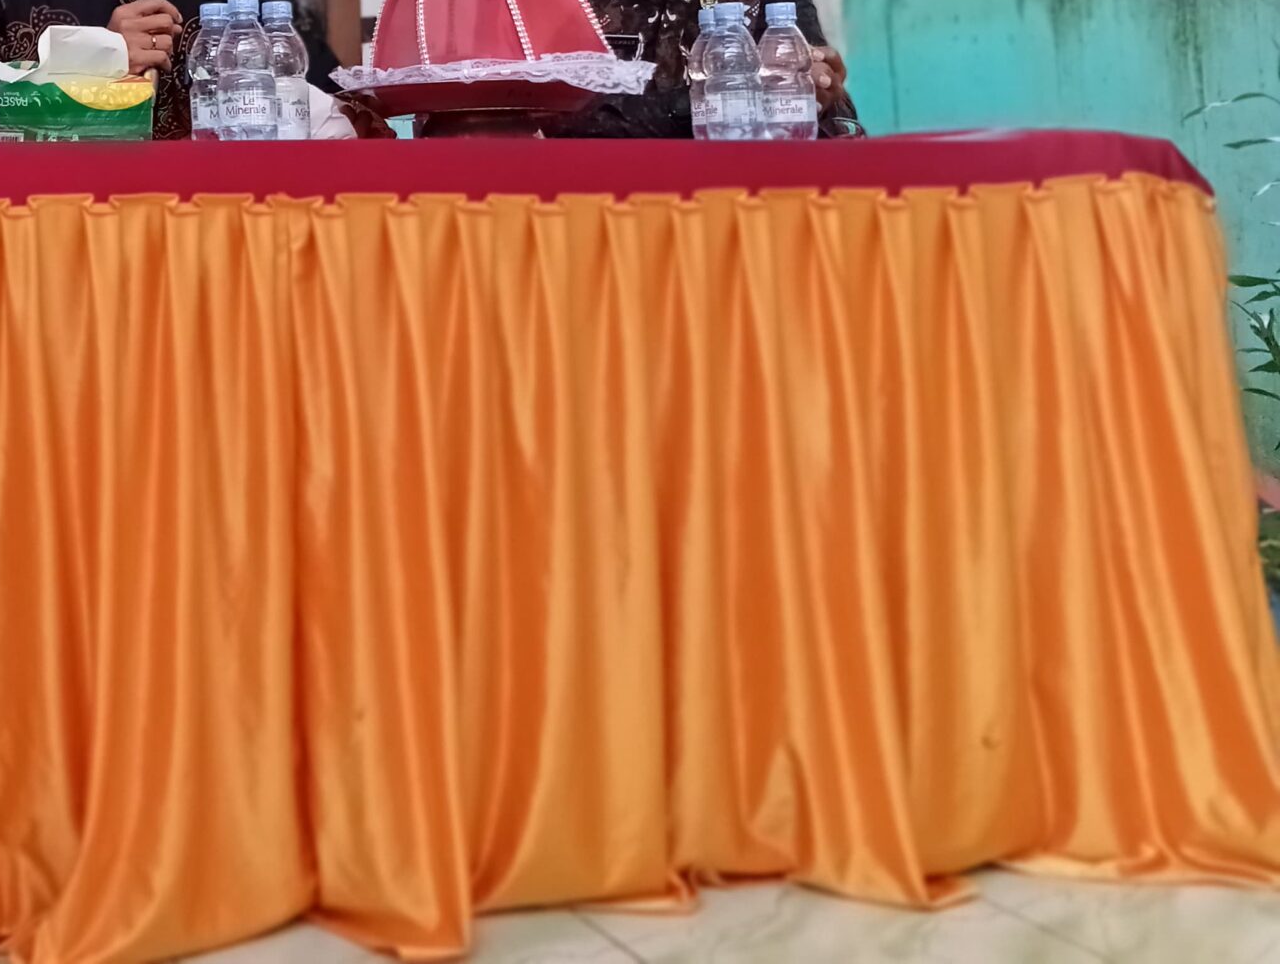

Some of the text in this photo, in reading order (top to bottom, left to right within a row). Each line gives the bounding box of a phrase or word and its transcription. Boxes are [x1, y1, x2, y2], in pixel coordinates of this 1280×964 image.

[243, 96, 255, 105] Le
[780, 98, 791, 106] Le
[225, 105, 267, 115] Minerale
[762, 104, 803, 115] Minerale
